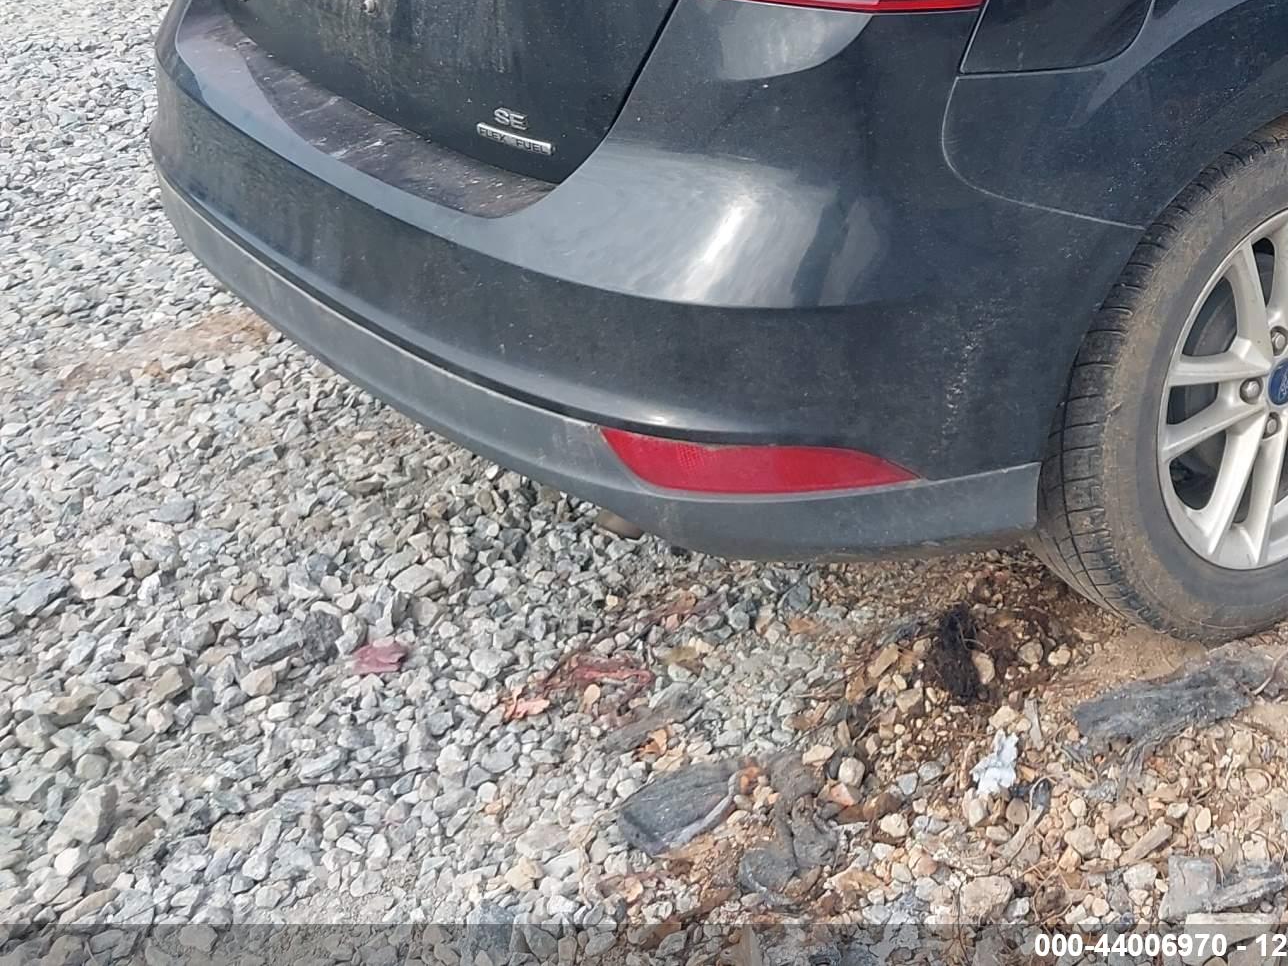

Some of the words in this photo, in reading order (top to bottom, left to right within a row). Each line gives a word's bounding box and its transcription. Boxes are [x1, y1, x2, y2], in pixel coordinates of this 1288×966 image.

[494, 107, 528, 130] SE
[479, 127, 506, 143] FLEX
[515, 138, 550, 154] FUEL
